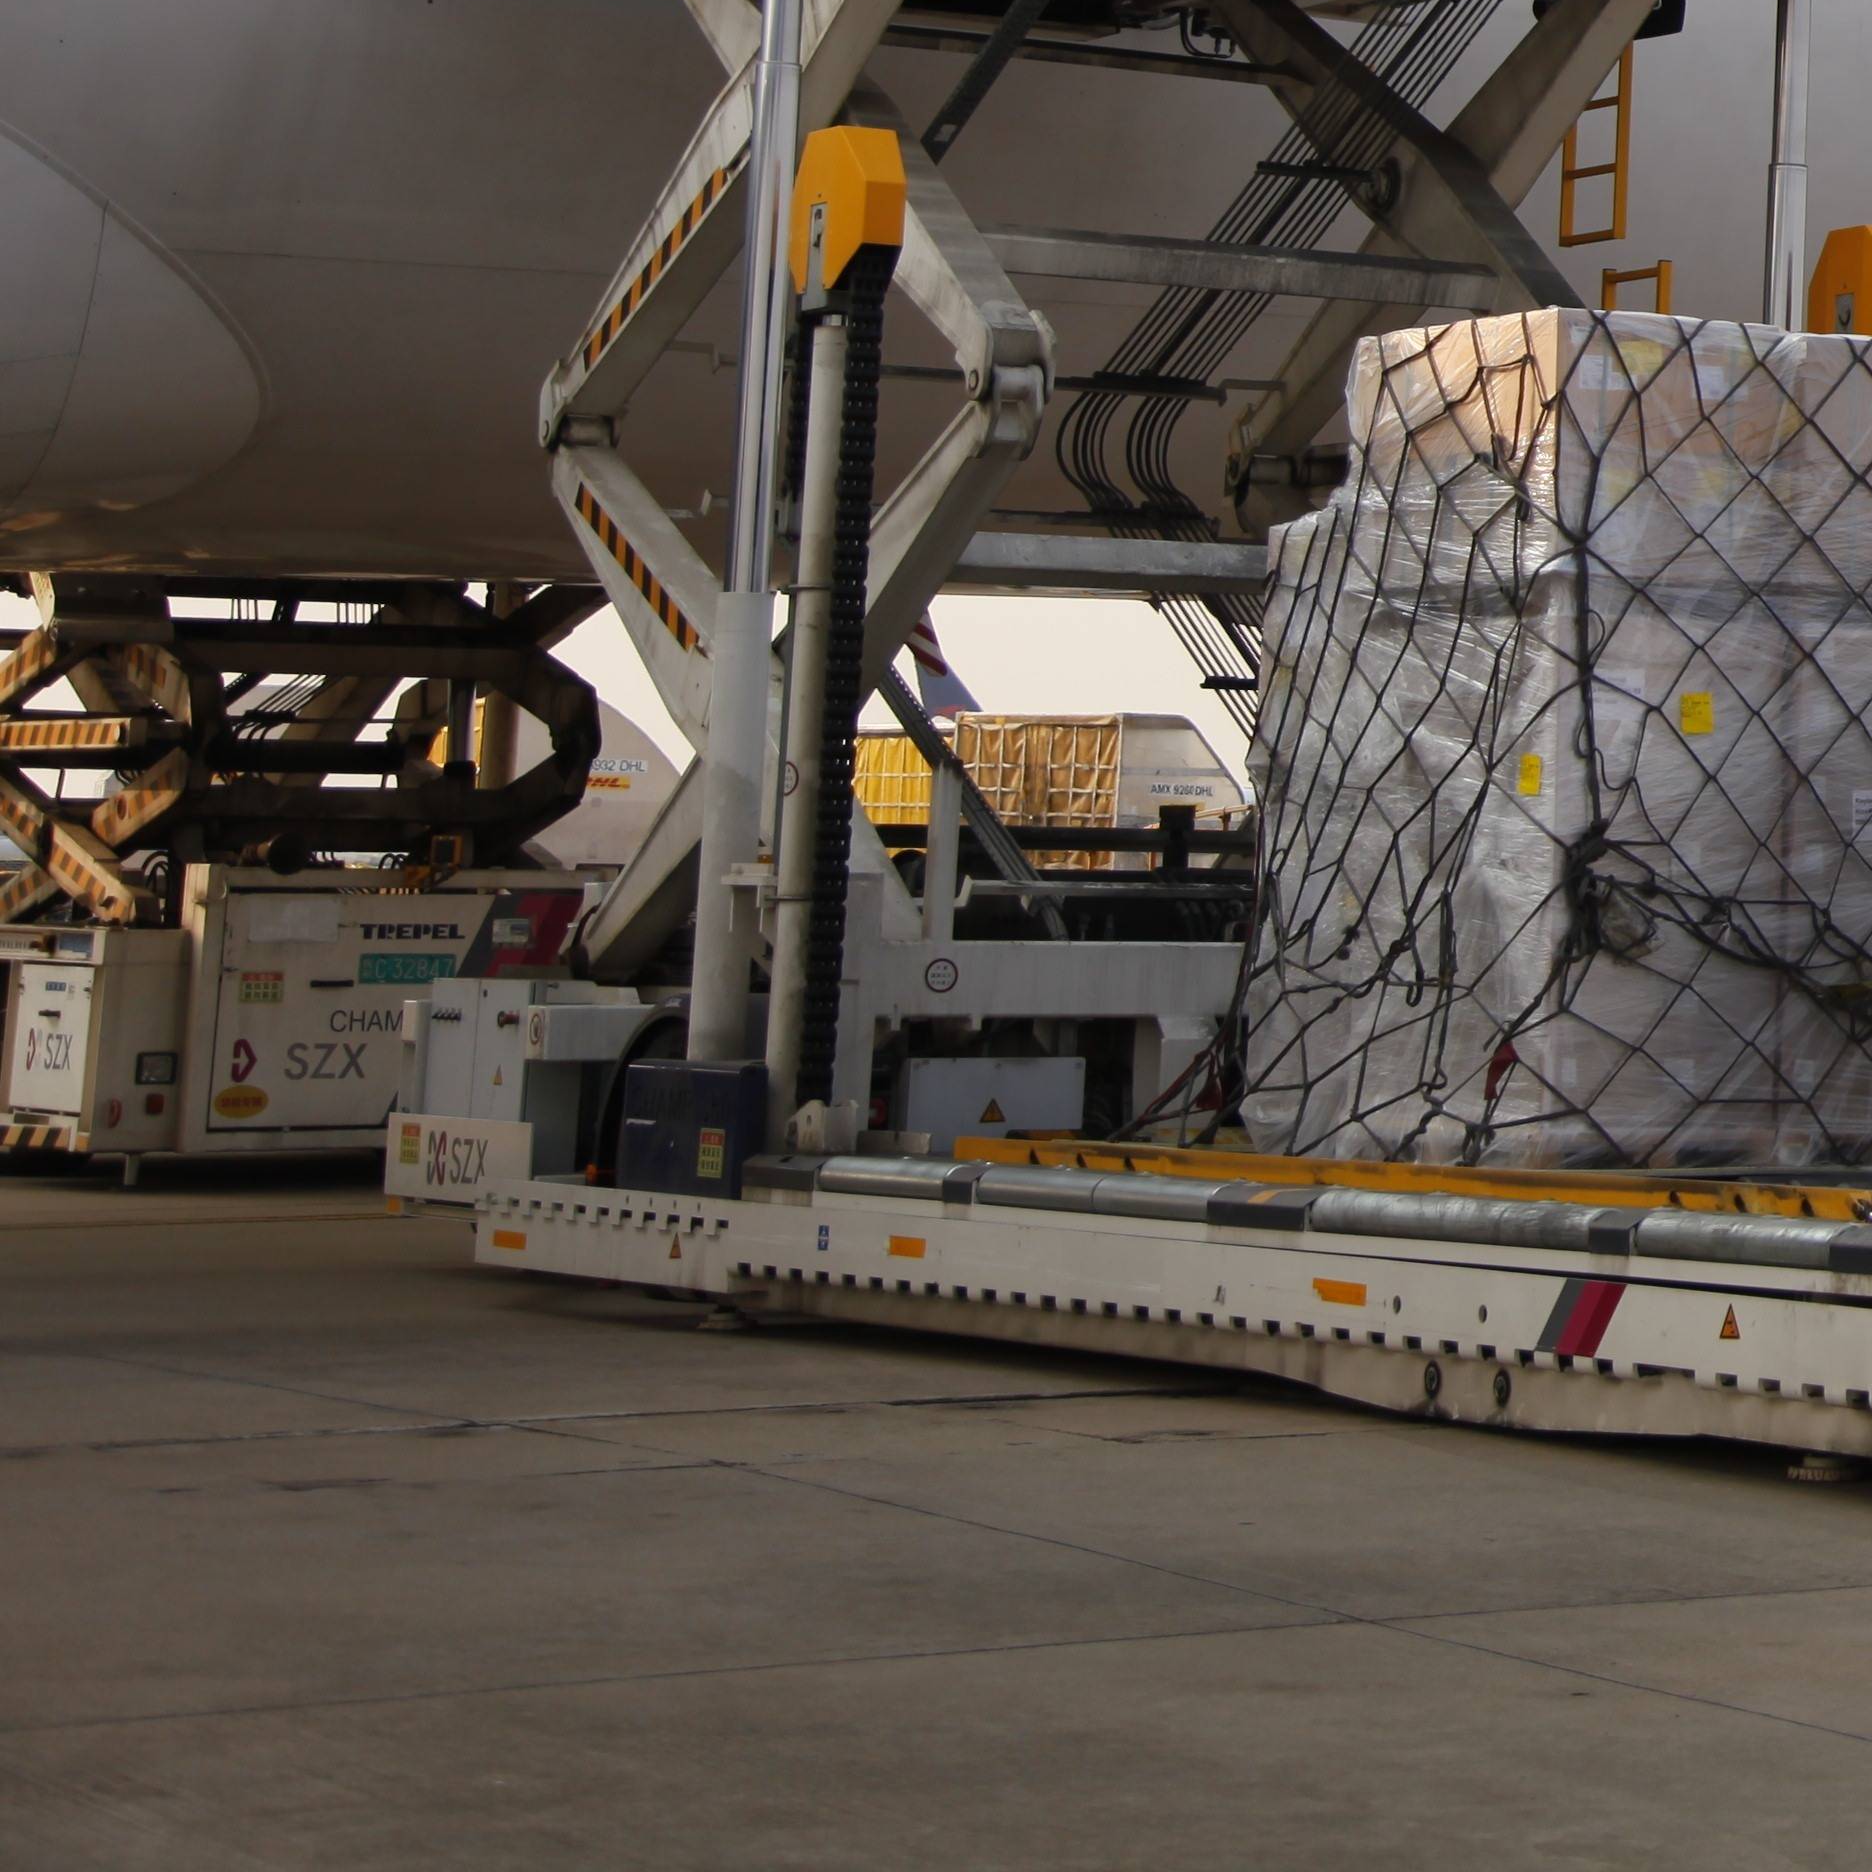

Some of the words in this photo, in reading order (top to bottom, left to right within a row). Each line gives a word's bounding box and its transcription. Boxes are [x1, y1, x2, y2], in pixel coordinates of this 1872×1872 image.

[592, 759, 616, 771] 932
[619, 759, 646, 773] DHL
[359, 923, 466, 941] TREPEL
[43, 1033, 74, 1072] SZX
[284, 1042, 369, 1081] SZX
[450, 1137, 488, 1185] SZX
